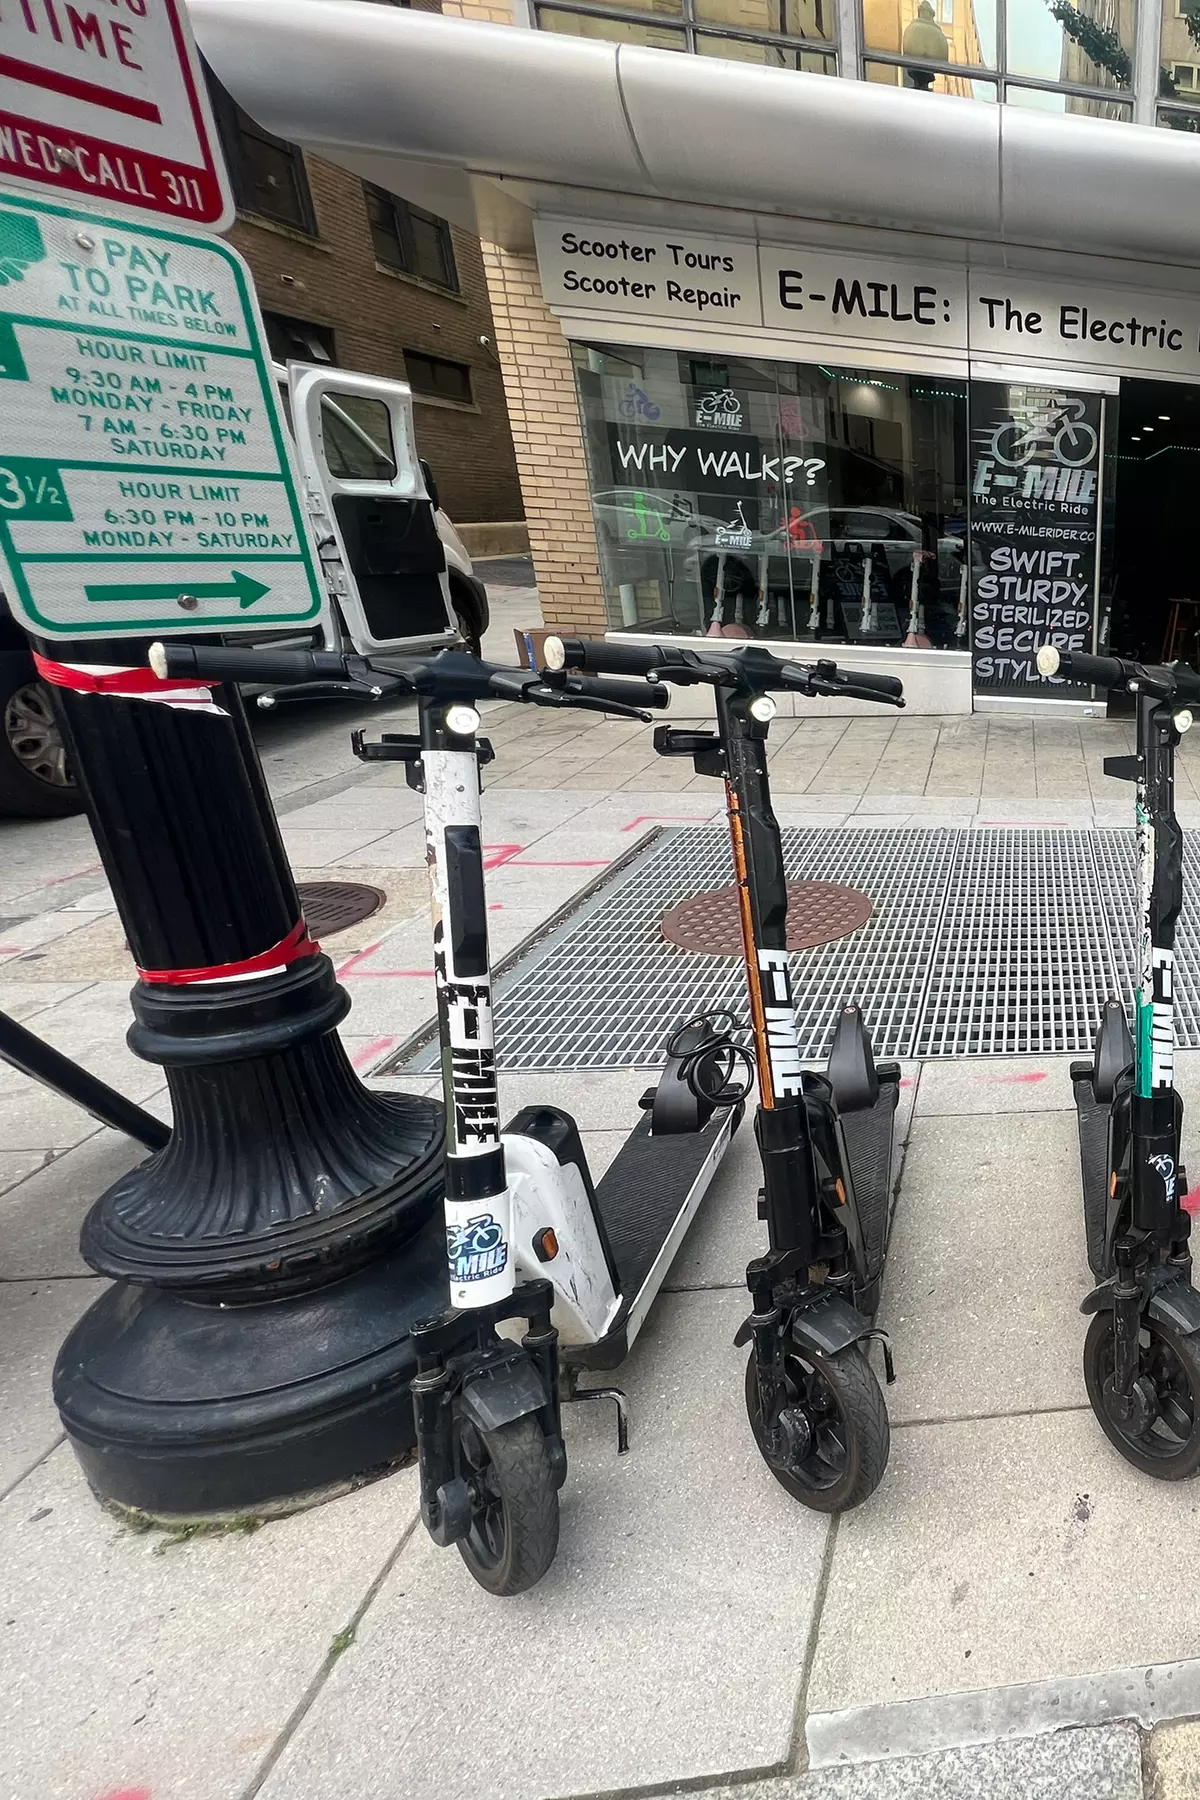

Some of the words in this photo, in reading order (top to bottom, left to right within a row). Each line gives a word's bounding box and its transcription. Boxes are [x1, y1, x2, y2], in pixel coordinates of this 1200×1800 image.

[74, 146, 156, 199] CALL
[161, 170, 205, 212] 311
[102, 238, 171, 277] PAY
[561, 232, 656, 263] Scooter
[666, 243, 735, 273] Tours
[60, 262, 110, 296] TO
[124, 274, 221, 317] PARK
[563, 270, 656, 300] Scooter
[666, 280, 741, 311] Repair
[57, 295, 80, 311] AT
[88, 302, 124, 319] ALL
[127, 306, 178, 328] TIMES
[183, 315, 238, 337] BELOW
[777, 269, 950, 325] E-MILE:
[979, 296, 1042, 334] The
[1059, 305, 1183, 351] Electric
[76, 338, 146, 364] HOUR
[152, 350, 208, 373] LIMIT
[66, 367, 121, 390] 9:30
[130, 376, 161, 394] AM
[185, 383, 198, 398] 4
[204, 385, 234, 402] PM
[50, 386, 153, 412] MONDAY
[178, 403, 253, 423] FRIDAY
[696, 410, 743, 427] E-MILE
[78, 414, 92, 431] 7
[103, 417, 136, 435] AM
[160, 423, 209, 442] 6:30
[217, 427, 247, 445] PM
[110, 437, 227, 461] SATURDAY
[616, 440, 687, 473] WHY
[697, 447, 826, 486] WALK??
[119, 481, 181, 501] HOUR
[189, 484, 241, 502] LIMIT
[972, 458, 1098, 504] E-MILE
[104, 508, 156, 526] 6:30
[165, 510, 194, 526] PM
[217, 511, 236, 527] 10
[243, 512, 269, 528] PM
[974, 494, 997, 506] The
[1002, 496, 1055, 512] Electric
[1060, 503, 1089, 515] Ride
[83, 530, 173, 547] MONDAY
[197, 532, 293, 548] SATURDAY
[989, 546, 1084, 578] SWIFT.
[977, 575, 1089, 607] STURDY.
[757, 949, 803, 1098] E-MILE
[483, 1266, 502, 1278] Ride
